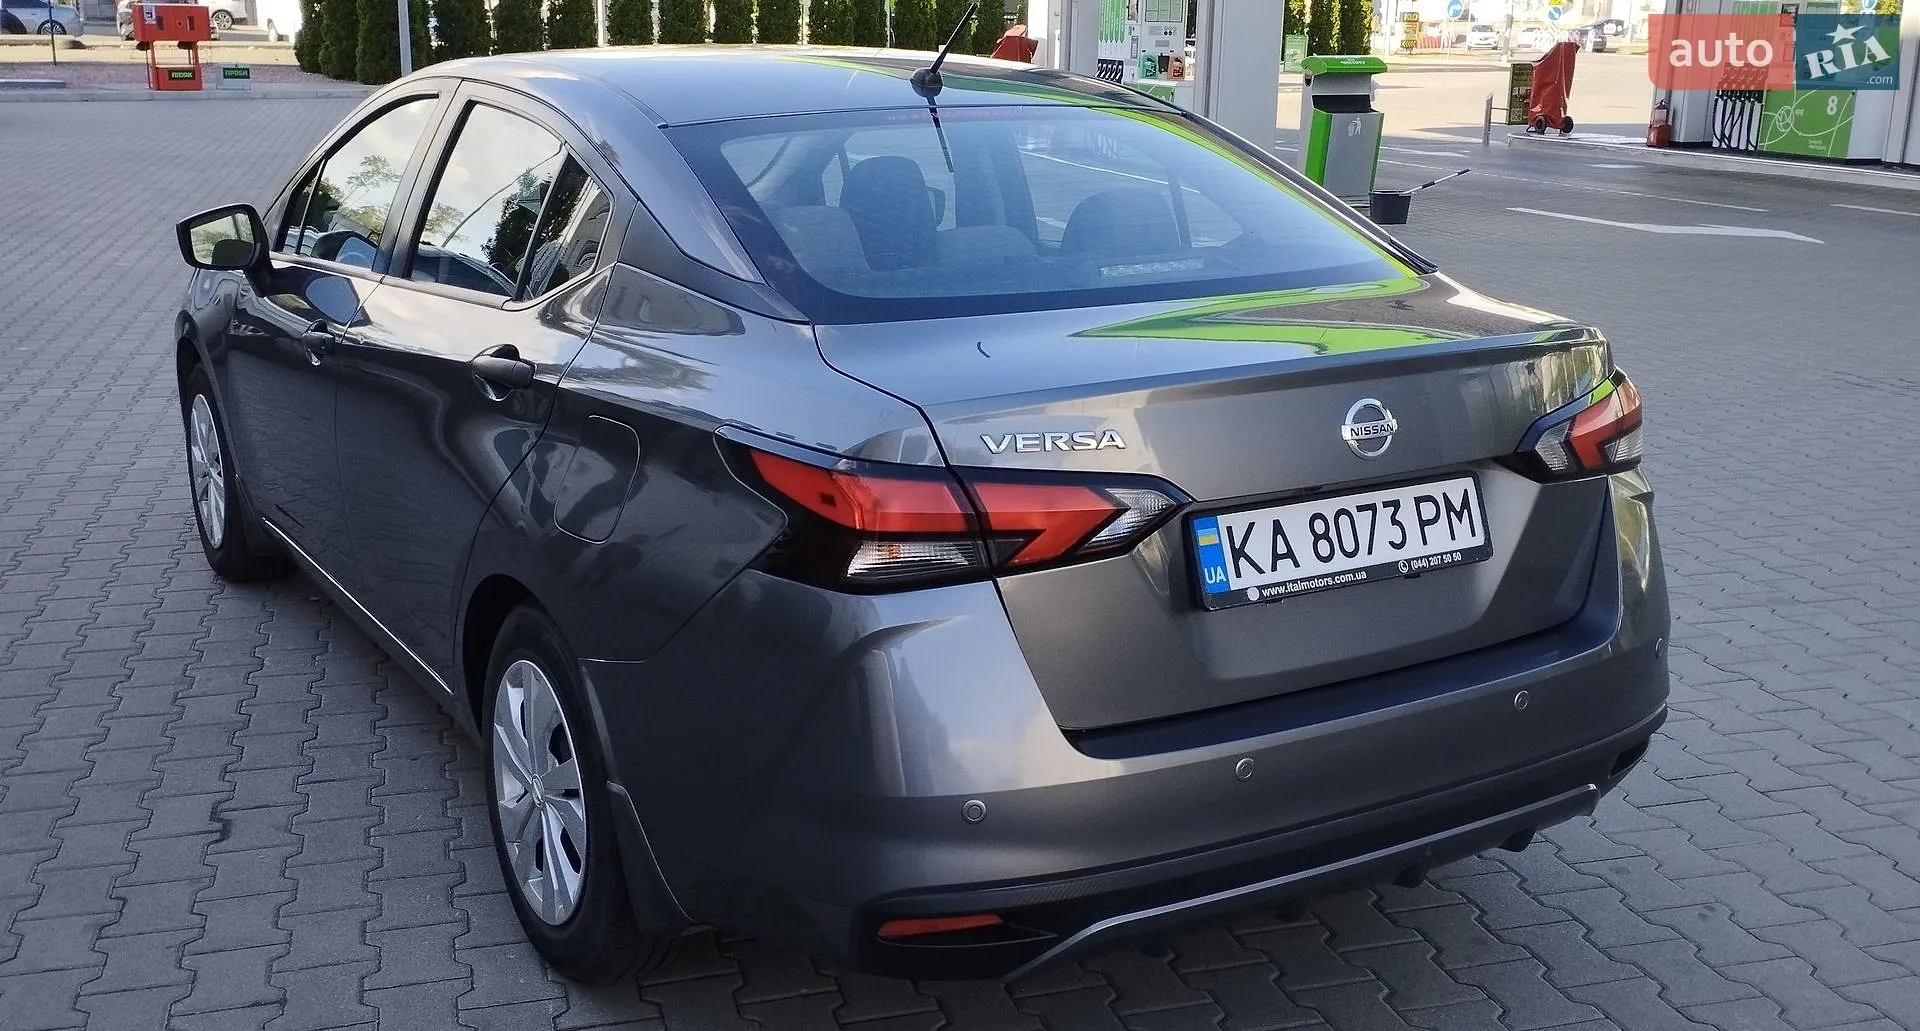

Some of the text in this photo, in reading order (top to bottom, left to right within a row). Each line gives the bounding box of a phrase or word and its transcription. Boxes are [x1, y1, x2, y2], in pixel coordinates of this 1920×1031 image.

[1826, 95, 1838, 116] 8
[1350, 423, 1396, 438] NISSAN
[980, 429, 1127, 455] VERSA
[1226, 488, 1477, 579] KA 8073 PM
[1411, 551, 1462, 571] (044) 207 50 50
[1205, 567, 1227, 585] UA
[1261, 570, 1367, 597] www.italmotors.com.ua
